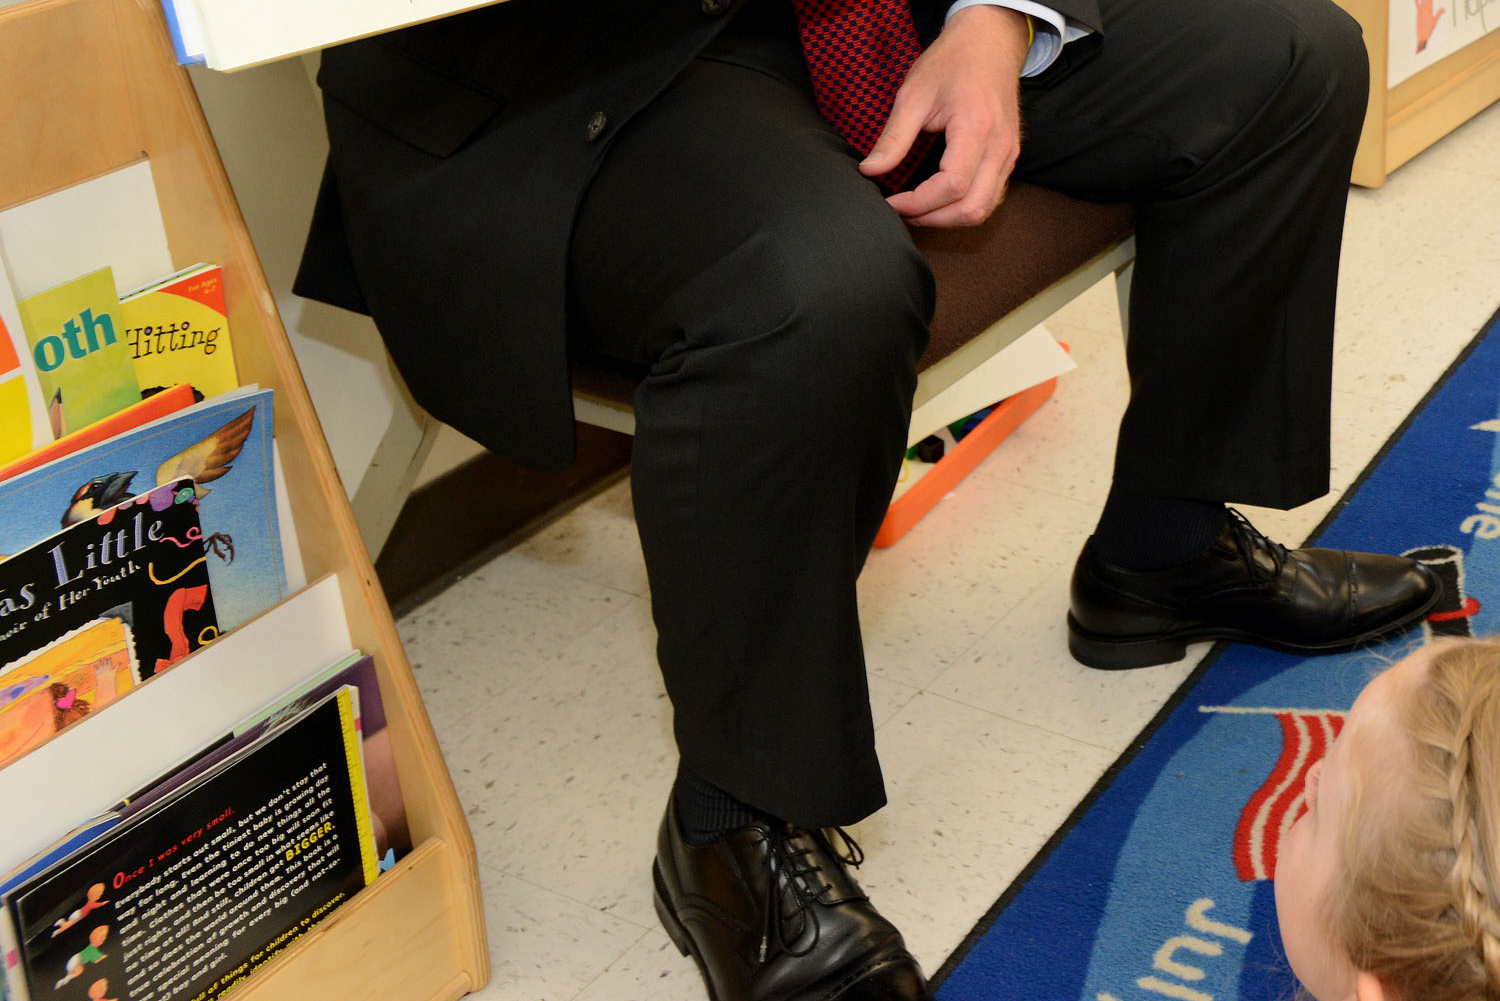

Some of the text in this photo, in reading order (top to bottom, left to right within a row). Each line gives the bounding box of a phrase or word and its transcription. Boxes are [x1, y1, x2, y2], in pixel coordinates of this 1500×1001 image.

[125, 321, 221, 360] Hitting
[200, 278, 217, 290] Ages
[0, 511, 166, 617] as Little
[34, 601, 53, 623] of
[58, 587, 92, 612] Her
[91, 560, 142, 592] Youth
[112, 866, 144, 889] Once
[148, 858, 153, 867] I
[157, 844, 178, 860] was
[181, 828, 203, 845] very
[114, 875, 161, 908] Everybody
[163, 855, 192, 877] starts
[192, 843, 209, 856] out
[237, 813, 253, 827] but
[254, 805, 266, 815] we
[268, 788, 290, 807] don't
[291, 776, 308, 790] stay
[309, 762, 326, 777] that
[116, 906, 135, 921] way
[137, 894, 153, 907] for
[181, 862, 202, 879] Even
[204, 850, 220, 863] the
[221, 828, 251, 851] tiniest
[252, 814, 272, 830] baby
[274, 808, 282, 816] is
[283, 785, 314, 810] growing
[315, 774, 328, 787] day
[119, 787, 330, 934] and night and learning to do new things all the
[123, 943, 142, 962] just
[173, 909, 191, 925] and
[191, 896, 213, 912] then
[214, 887, 225, 897] be
[226, 875, 243, 888] too
[243, 858, 265, 877] small
[265, 854, 274, 862] in
[274, 838, 295, 855] what
[296, 821, 319, 840] seems
[319, 810, 334, 823] like
[125, 961, 138, 972] no
[139, 945, 160, 962] time
[162, 936, 173, 947] at
[192, 910, 209, 926] And
[234, 871, 268, 897] children
[269, 859, 283, 874] get
[285, 821, 335, 861] BIGGER.
[148, 902, 184, 928] Clothes
[186, 886, 206, 903] that
[208, 871, 230, 887] were
[231, 855, 252, 871] once
[254, 843, 269, 856] too
[271, 833, 285, 844] big
[286, 820, 300, 833] will
[301, 807, 320, 823] soon
[321, 798, 332, 808] fit
[128, 843, 339, 997] true celebration of growth and discovery that will
[1097, 897, 1254, 1001] Jul
